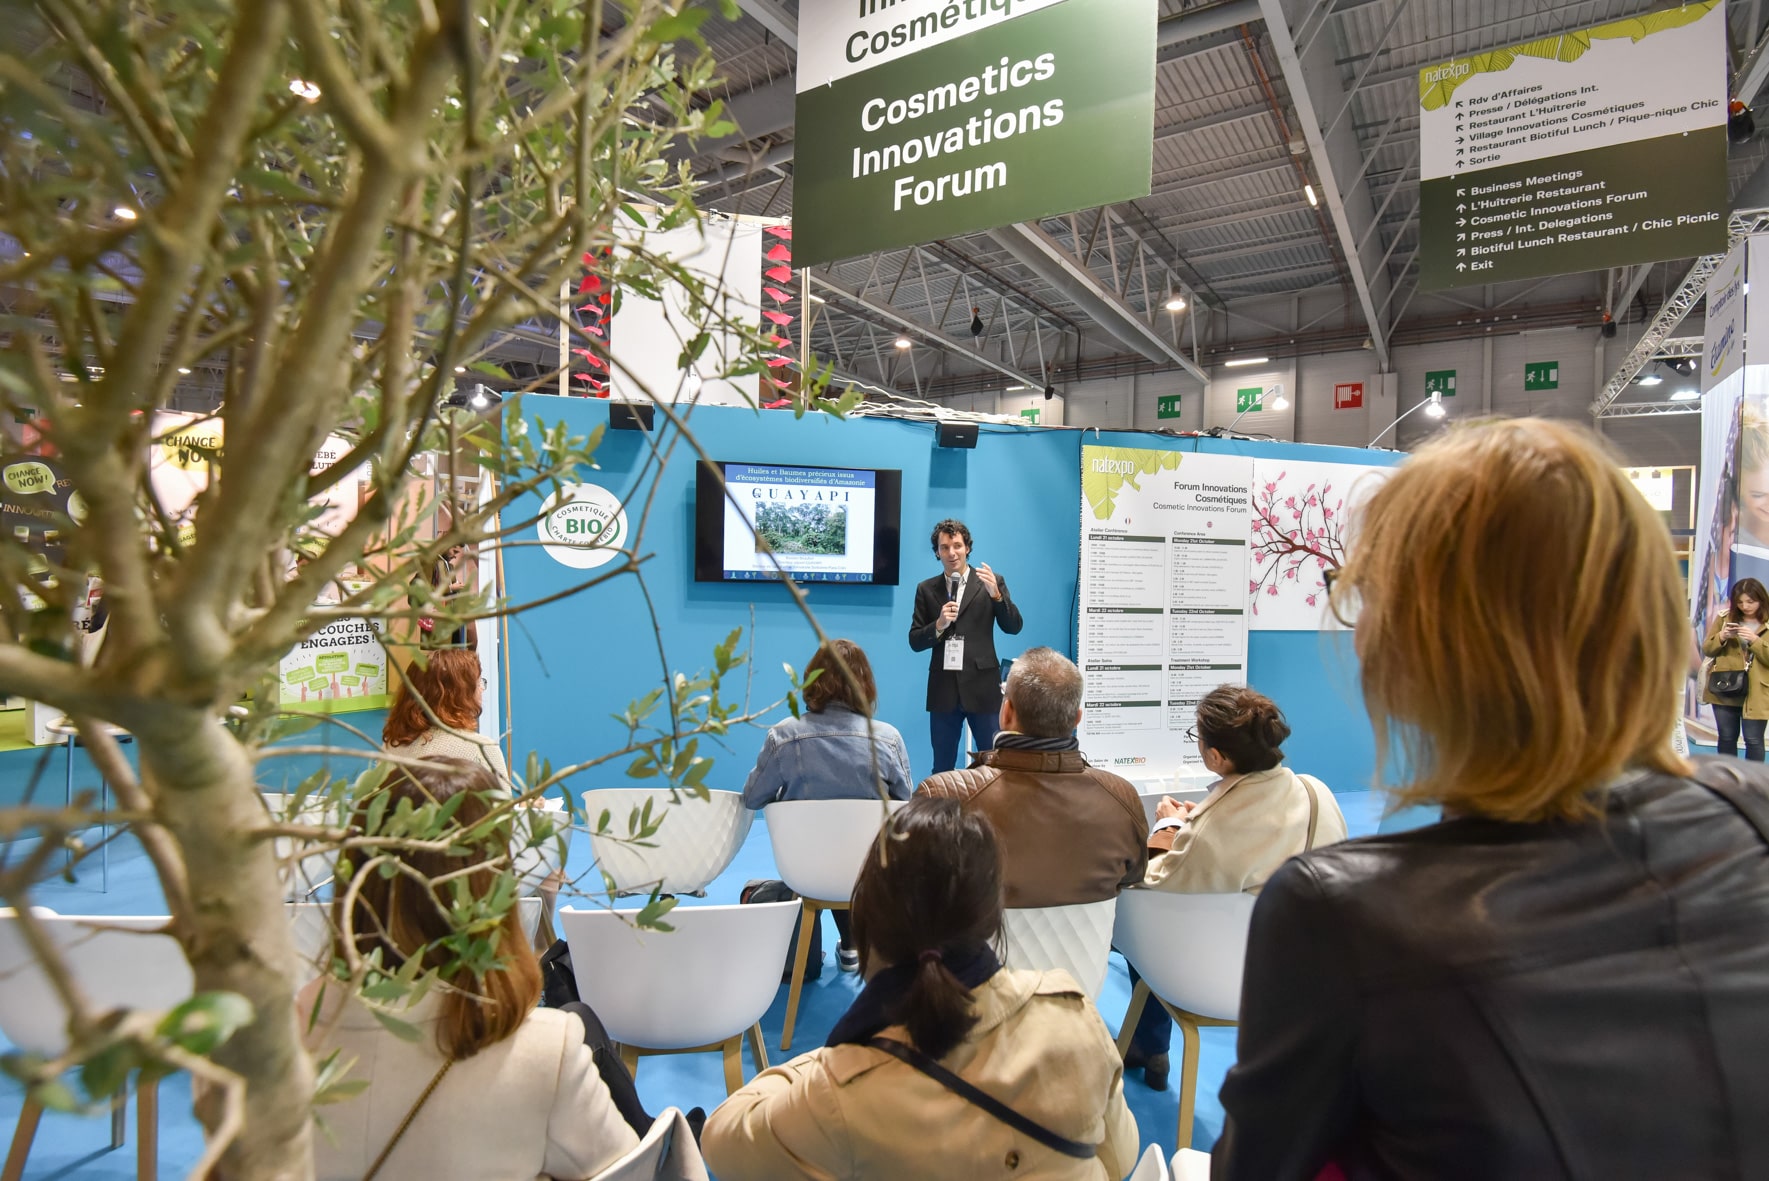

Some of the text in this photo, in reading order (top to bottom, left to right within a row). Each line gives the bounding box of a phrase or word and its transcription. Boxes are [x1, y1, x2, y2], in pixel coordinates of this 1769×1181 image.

[1425, 62, 1470, 84] natexpo
[861, 52, 1055, 132] Cosmetics
[1469, 84, 1543, 106] Rdv d'Affaires
[1469, 105, 1504, 118] Presse
[1514, 89, 1577, 108] Délégations
[1580, 84, 1599, 94] Int.
[1469, 99, 1586, 130] Restaurant L'Huîtrerie
[1469, 100, 1645, 142] Village Innovations Cosmétiques
[1469, 136, 1527, 153] Restaurant
[1530, 127, 1569, 142] Biotiful
[1573, 121, 1606, 133] Lunch
[1618, 106, 1687, 125] Pique-nique
[1690, 98, 1719, 111] Chic
[852, 98, 1064, 179] Innovations
[1469, 153, 1501, 166] Sortie
[893, 161, 1008, 212] Forum
[1471, 170, 1583, 196] Business Meetings
[1471, 181, 1606, 211] L'Huîtrerie Restaurant
[1470, 190, 1648, 226] Cosmetic Innovations Forum
[1471, 228, 1503, 240] Press
[1515, 224, 1535, 234] Int.
[1538, 212, 1613, 231] Delegations
[1471, 241, 1514, 256] Biotiful
[1518, 236, 1554, 249] Lunch
[1558, 225, 1629, 243] Restaurant
[1641, 218, 1673, 231] Chic
[1677, 212, 1720, 226] Picnic
[1471, 260, 1494, 271] Exit
[166, 435, 216, 448] CHANGE
[8, 467, 41, 481] CHANGE
[747, 467, 769, 475] Huiles
[807, 470, 836, 479] précieux
[1092, 455, 1135, 477] natexpo
[828, 477, 866, 487] d'Amazonie
[1174, 482, 1248, 494] Forum Innovations
[752, 487, 849, 502] GUAYAPI
[1195, 494, 1247, 505] Cosmétiques
[556, 506, 609, 520] COSMETIQUE
[1153, 502, 1247, 514] Cosmetic Innovations Forum
[566, 518, 602, 535] BIO
[301, 634, 370, 649] ENGAGÉES
[1114, 757, 1146, 765] NATEXBIO
